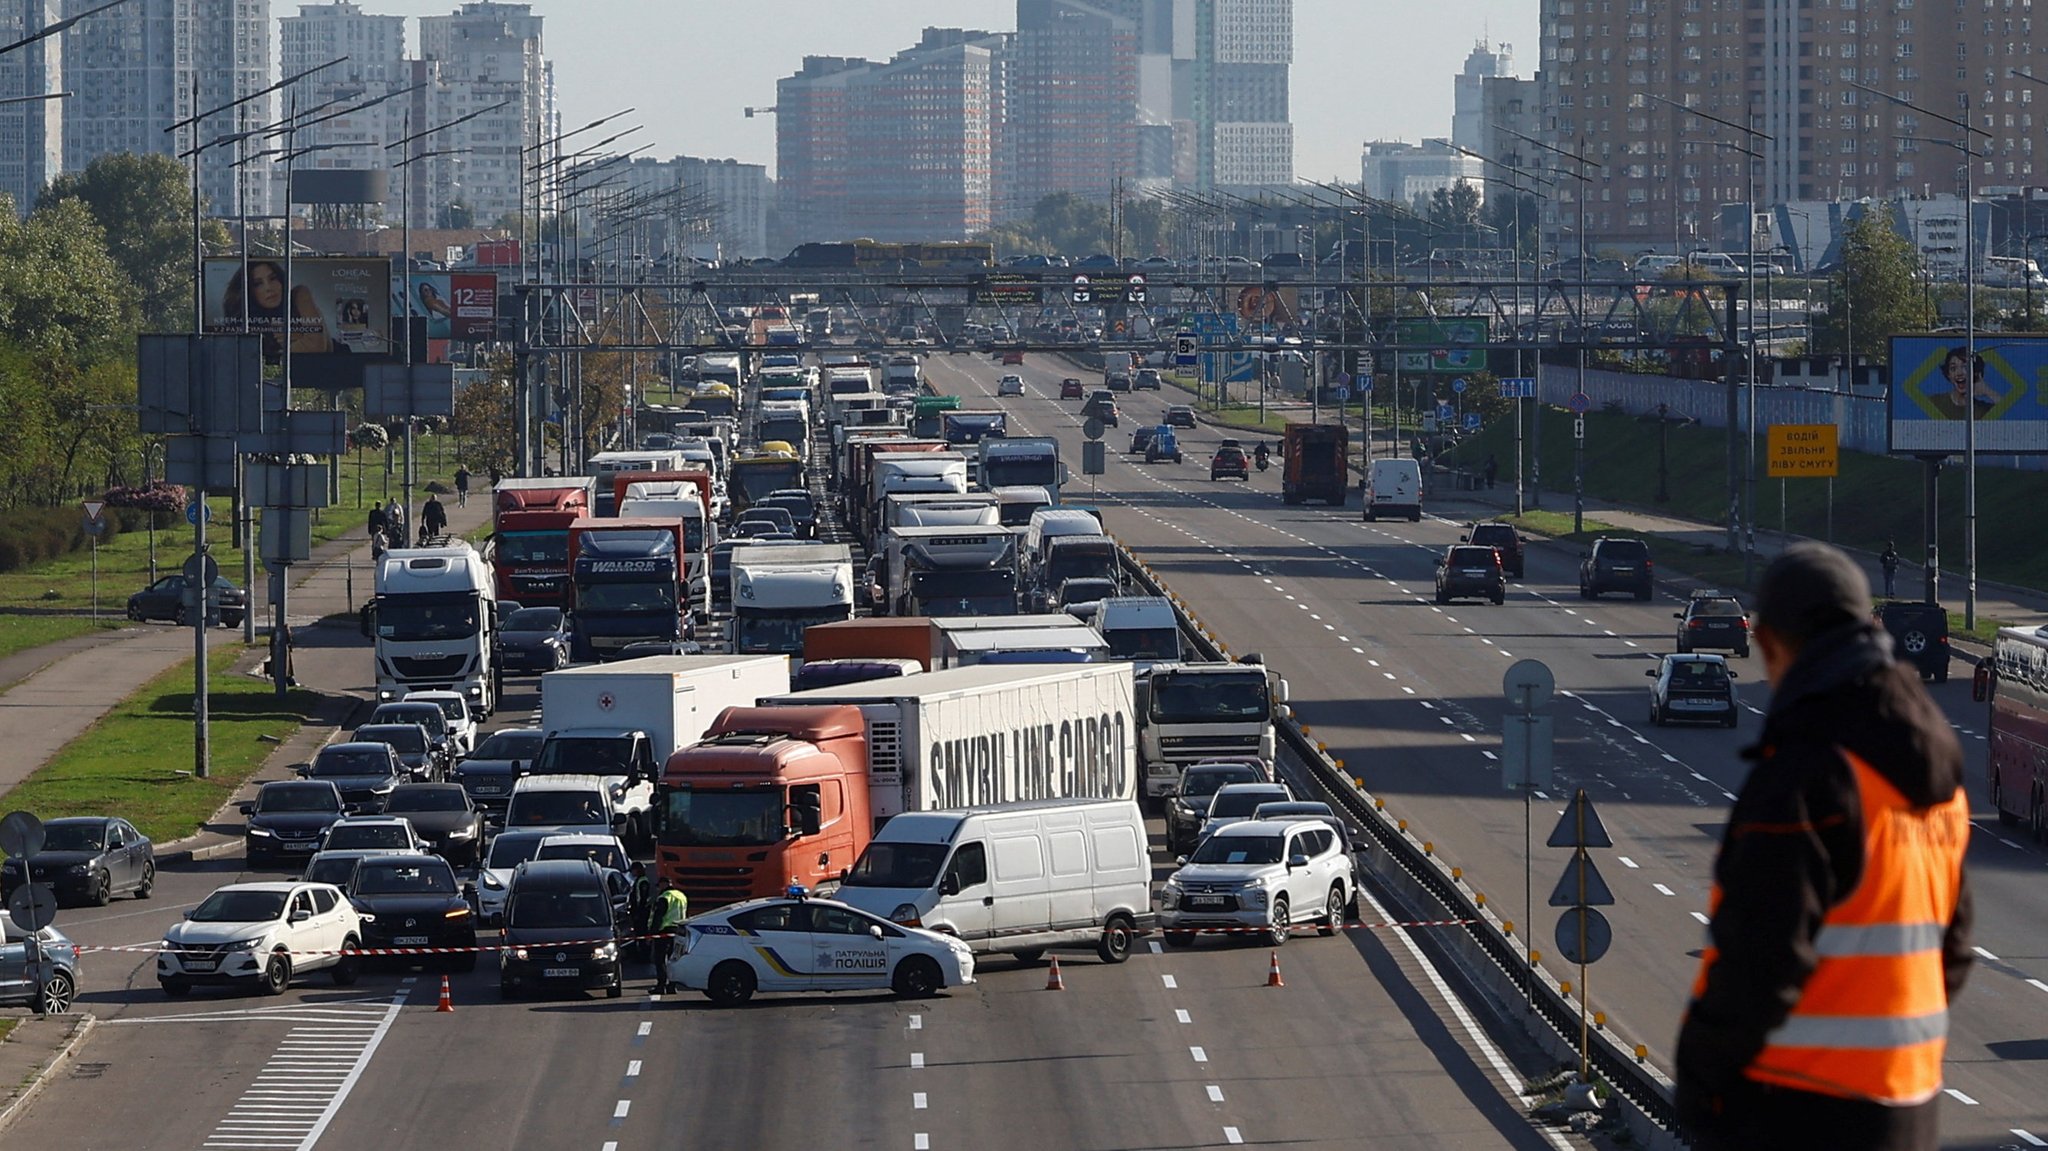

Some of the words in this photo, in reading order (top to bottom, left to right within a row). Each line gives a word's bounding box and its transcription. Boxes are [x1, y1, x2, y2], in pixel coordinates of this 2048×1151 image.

[454, 288, 474, 304] 12
[1787, 431, 1819, 441] ВОДІЙ
[1780, 446, 1825, 455] ЗВІЛЬНИ
[1771, 460, 1795, 469] ЛІВУ
[1799, 460, 1834, 469] СМУГУ
[592, 561, 656, 573] WALDOR
[1013, 724, 1056, 801] LINE
[1059, 710, 1126, 799] CARGO
[715, 926, 728, 934] 102
[835, 950, 886, 958] ПАТРУЛЬНА
[835, 958, 887, 969] ПОЛІЦІЯ
